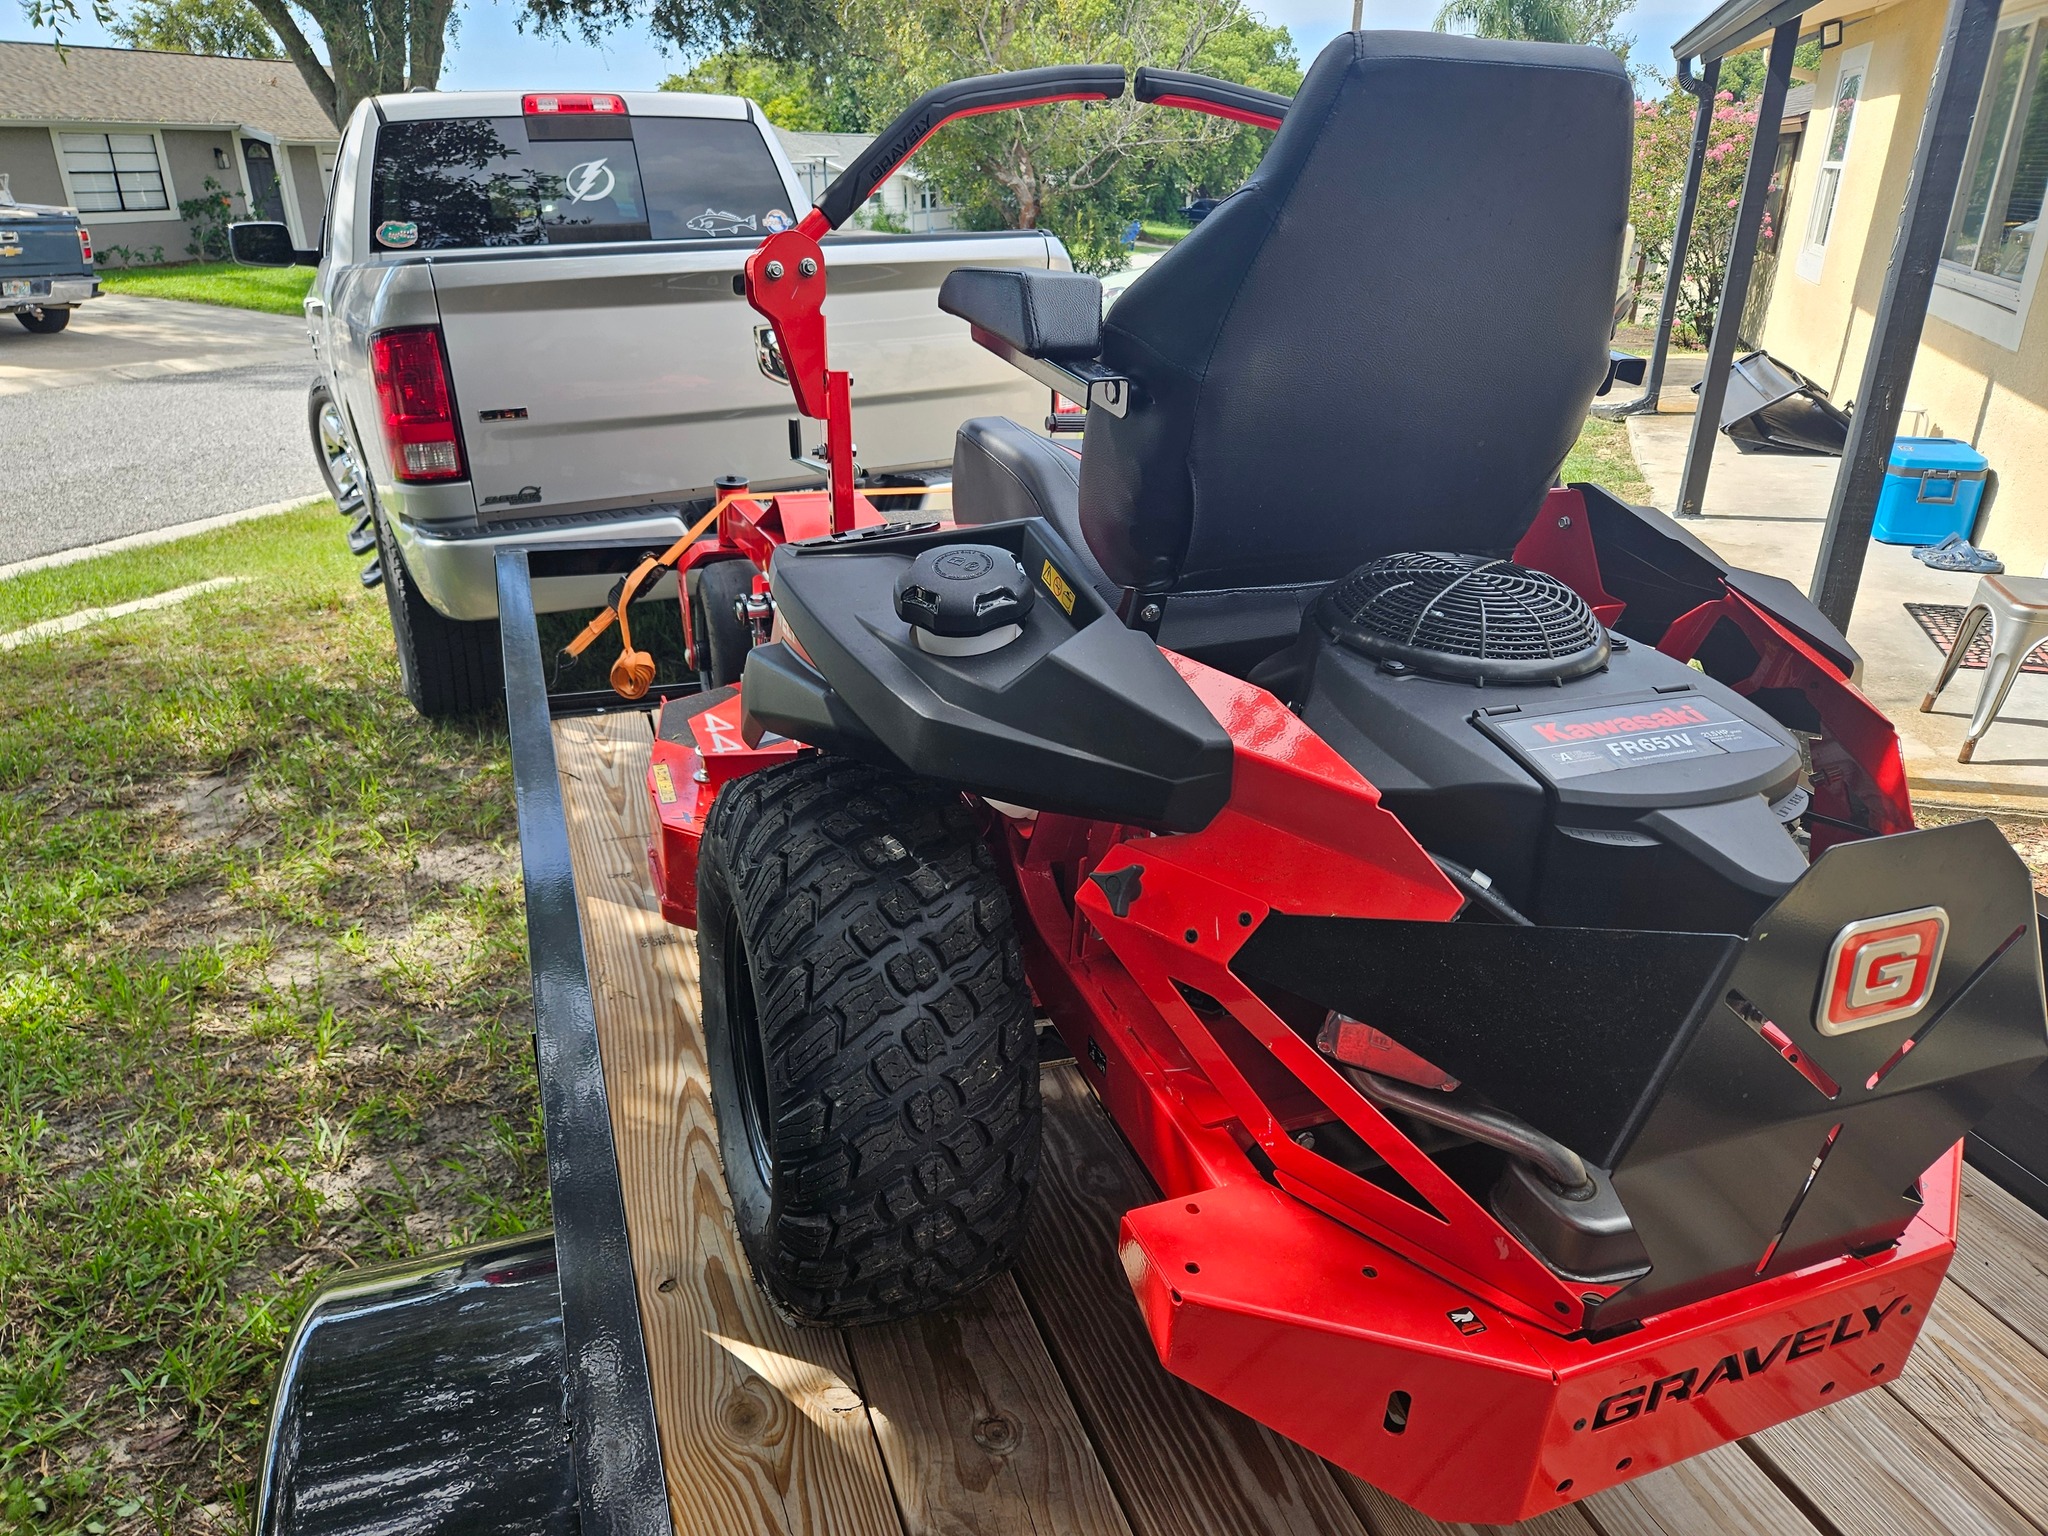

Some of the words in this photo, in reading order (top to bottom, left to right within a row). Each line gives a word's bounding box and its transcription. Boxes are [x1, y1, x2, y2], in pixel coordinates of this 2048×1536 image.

[704, 713, 743, 754] 44
[1532, 704, 1710, 743] Kawasaki
[1605, 732, 1694, 757] FR651V
[1846, 933, 1922, 1009] G
[1591, 1293, 1908, 1433] GRAVELY
